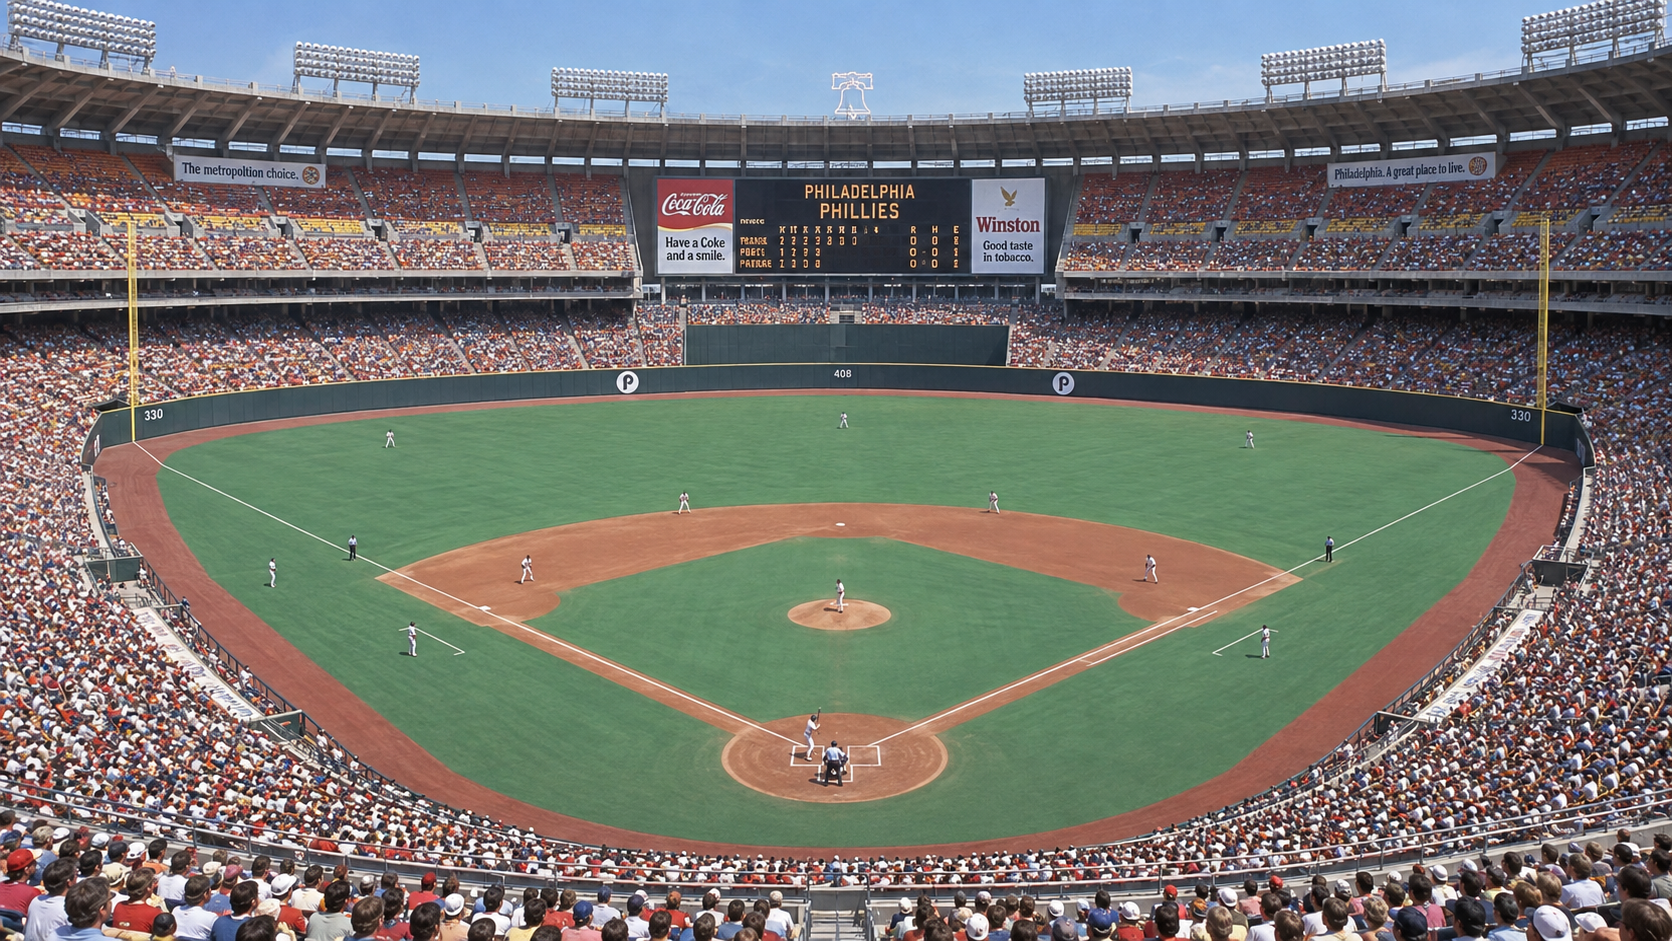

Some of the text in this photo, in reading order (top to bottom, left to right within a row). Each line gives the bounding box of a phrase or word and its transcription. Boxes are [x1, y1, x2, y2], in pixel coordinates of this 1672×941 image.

[182, 162, 201, 174] The
[266, 167, 299, 180] choice.
[1334, 161, 1466, 181] Philadelphia. A great place to live.
[805, 184, 915, 199] PHILADELPHIA
[820, 203, 899, 219] PHILLIES
[910, 225, 917, 234] R
[931, 225, 939, 234] H
[953, 225, 960, 234] E
[976, 216, 1041, 233] Winston
[665, 236, 690, 248] Have
[692, 239, 699, 248] a
[700, 236, 726, 248] Coke
[909, 235, 917, 246] 0
[983, 240, 1034, 250] Good taste
[666, 250, 726, 261] and a smile.
[909, 247, 917, 257] 0
[931, 247, 939, 257] 0
[983, 252, 1034, 262] in tobacco.
[909, 259, 917, 269] 0
[931, 259, 939, 269] 0
[834, 369, 852, 378] 408
[144, 408, 164, 421] 330
[1510, 409, 1531, 421] 330
